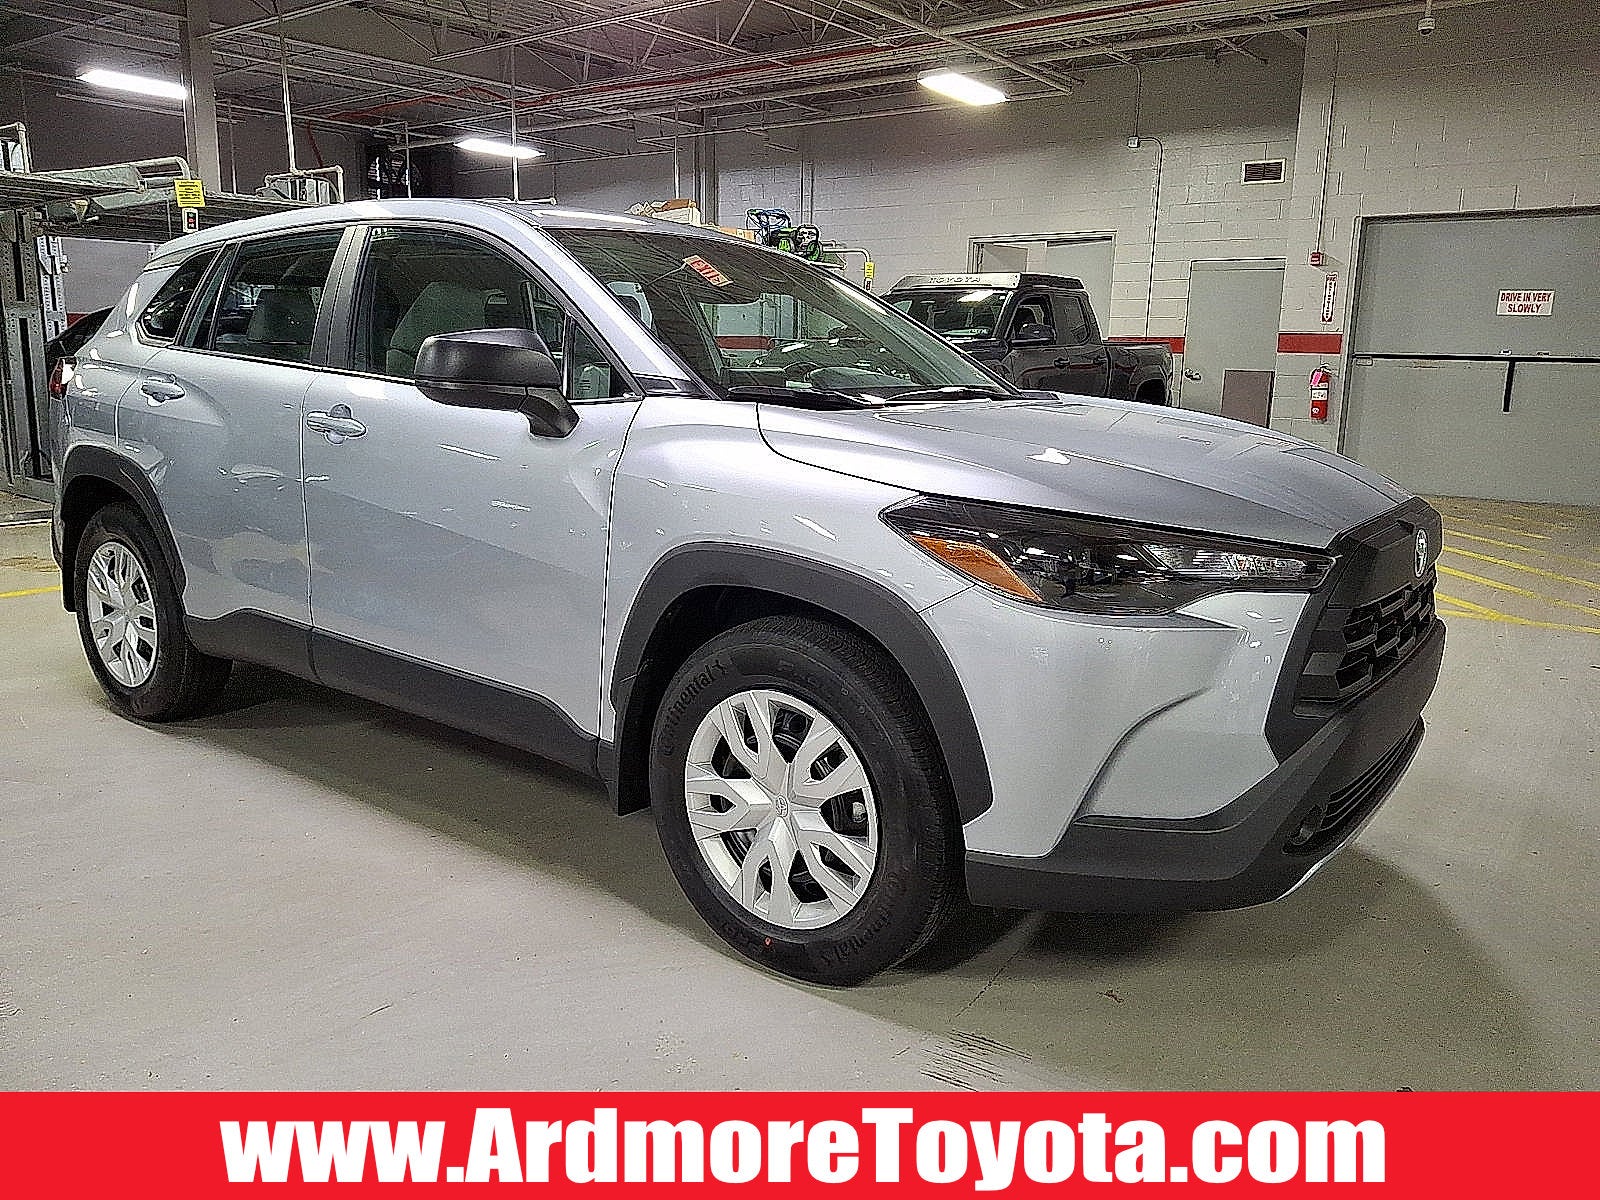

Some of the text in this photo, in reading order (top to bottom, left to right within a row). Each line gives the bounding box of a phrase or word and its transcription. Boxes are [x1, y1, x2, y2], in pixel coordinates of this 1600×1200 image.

[928, 276, 981, 284] TOYOTA
[1501, 292, 1551, 302] DRIVE IN VERY
[1507, 303, 1542, 313] SLOWLY
